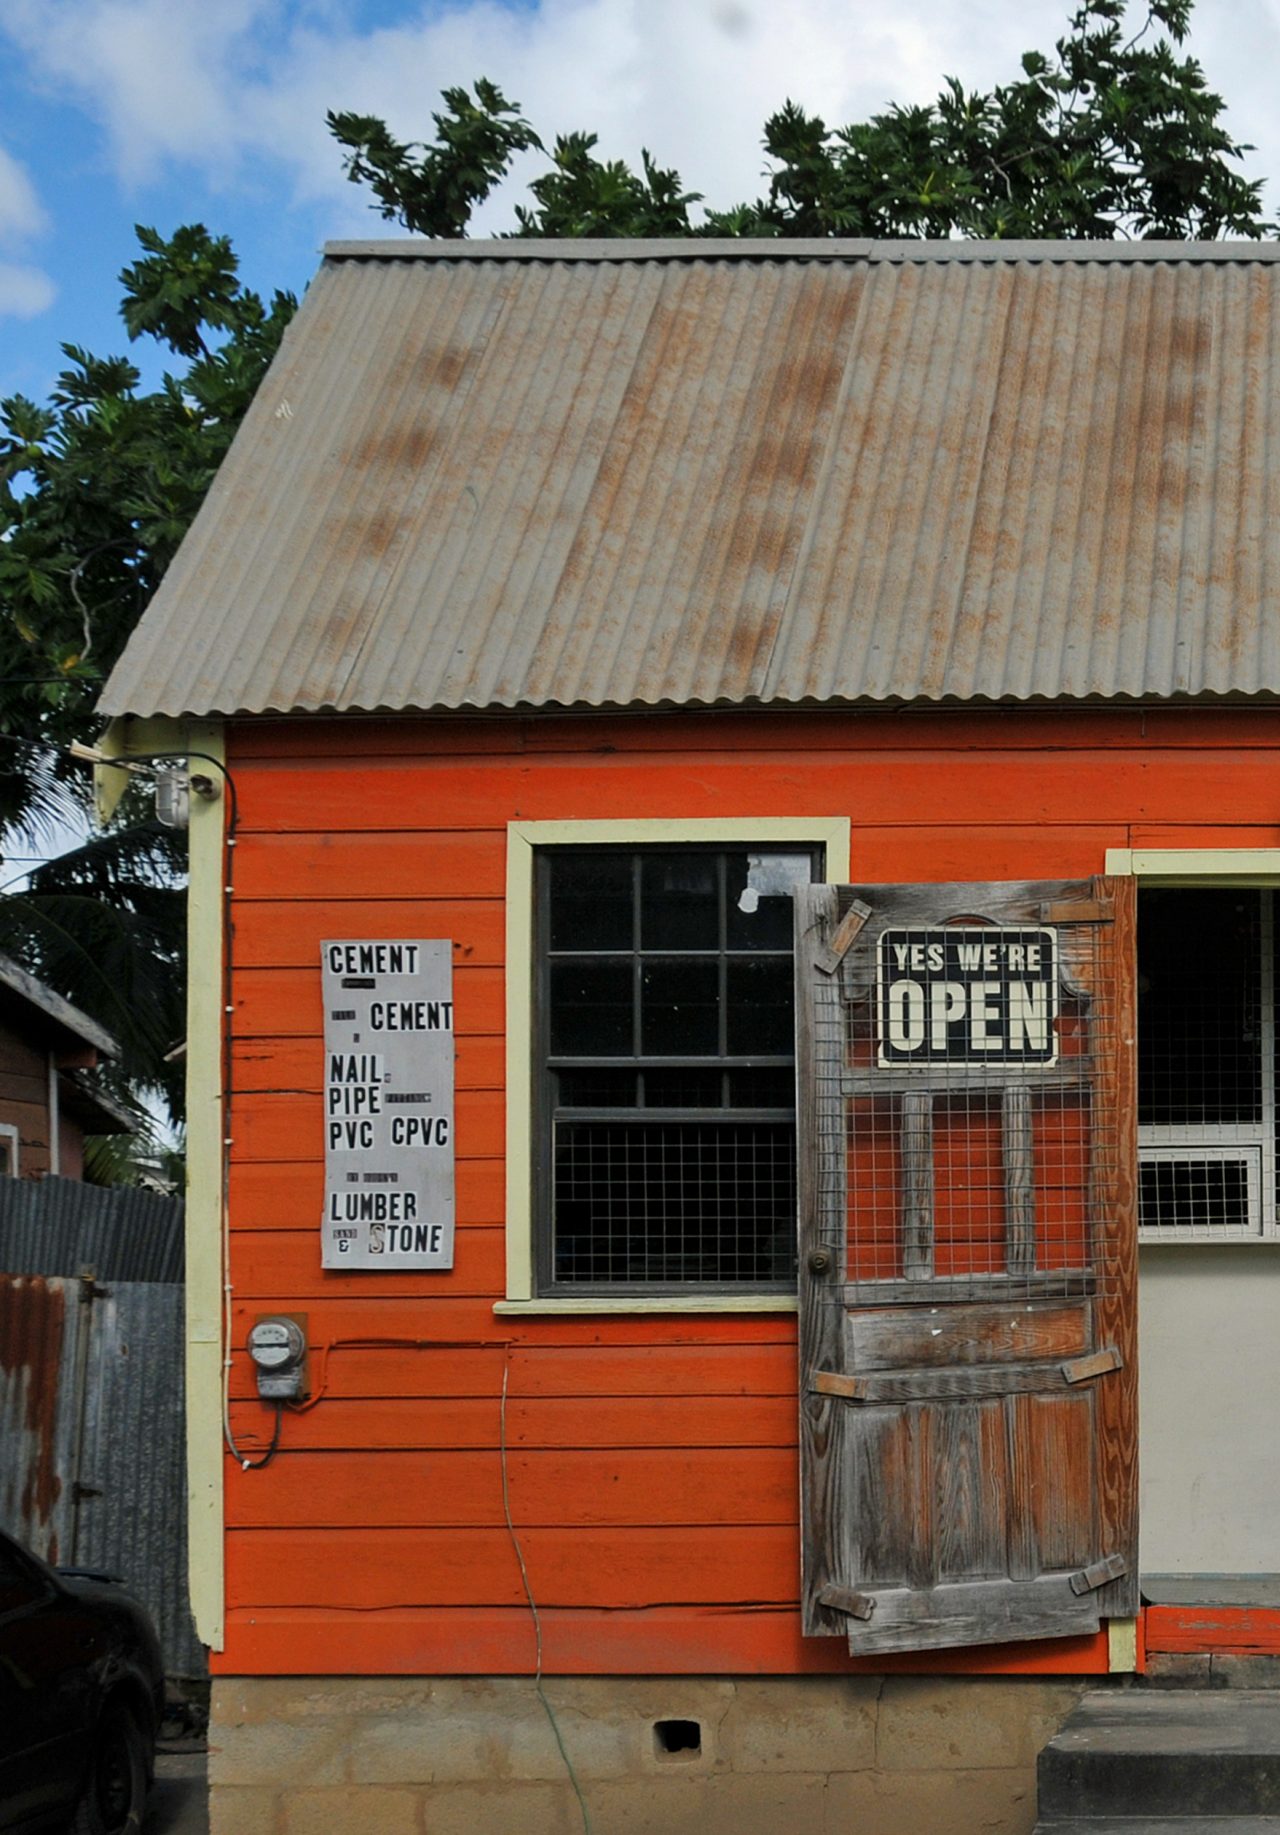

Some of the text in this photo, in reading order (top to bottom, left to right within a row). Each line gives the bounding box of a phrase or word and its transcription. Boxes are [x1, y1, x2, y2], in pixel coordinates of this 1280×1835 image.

[329, 945, 418, 974] CEMENT
[893, 943, 1041, 971] YES WE'RE
[370, 1001, 453, 1031] CEMENT
[889, 980, 1048, 1051] OPEN
[330, 1055, 382, 1083] NAIL
[329, 1086, 381, 1115] PIPE
[329, 1117, 448, 1150] PVC CPVC
[331, 1192, 416, 1221] LUMBER
[369, 1224, 443, 1252] STONE
